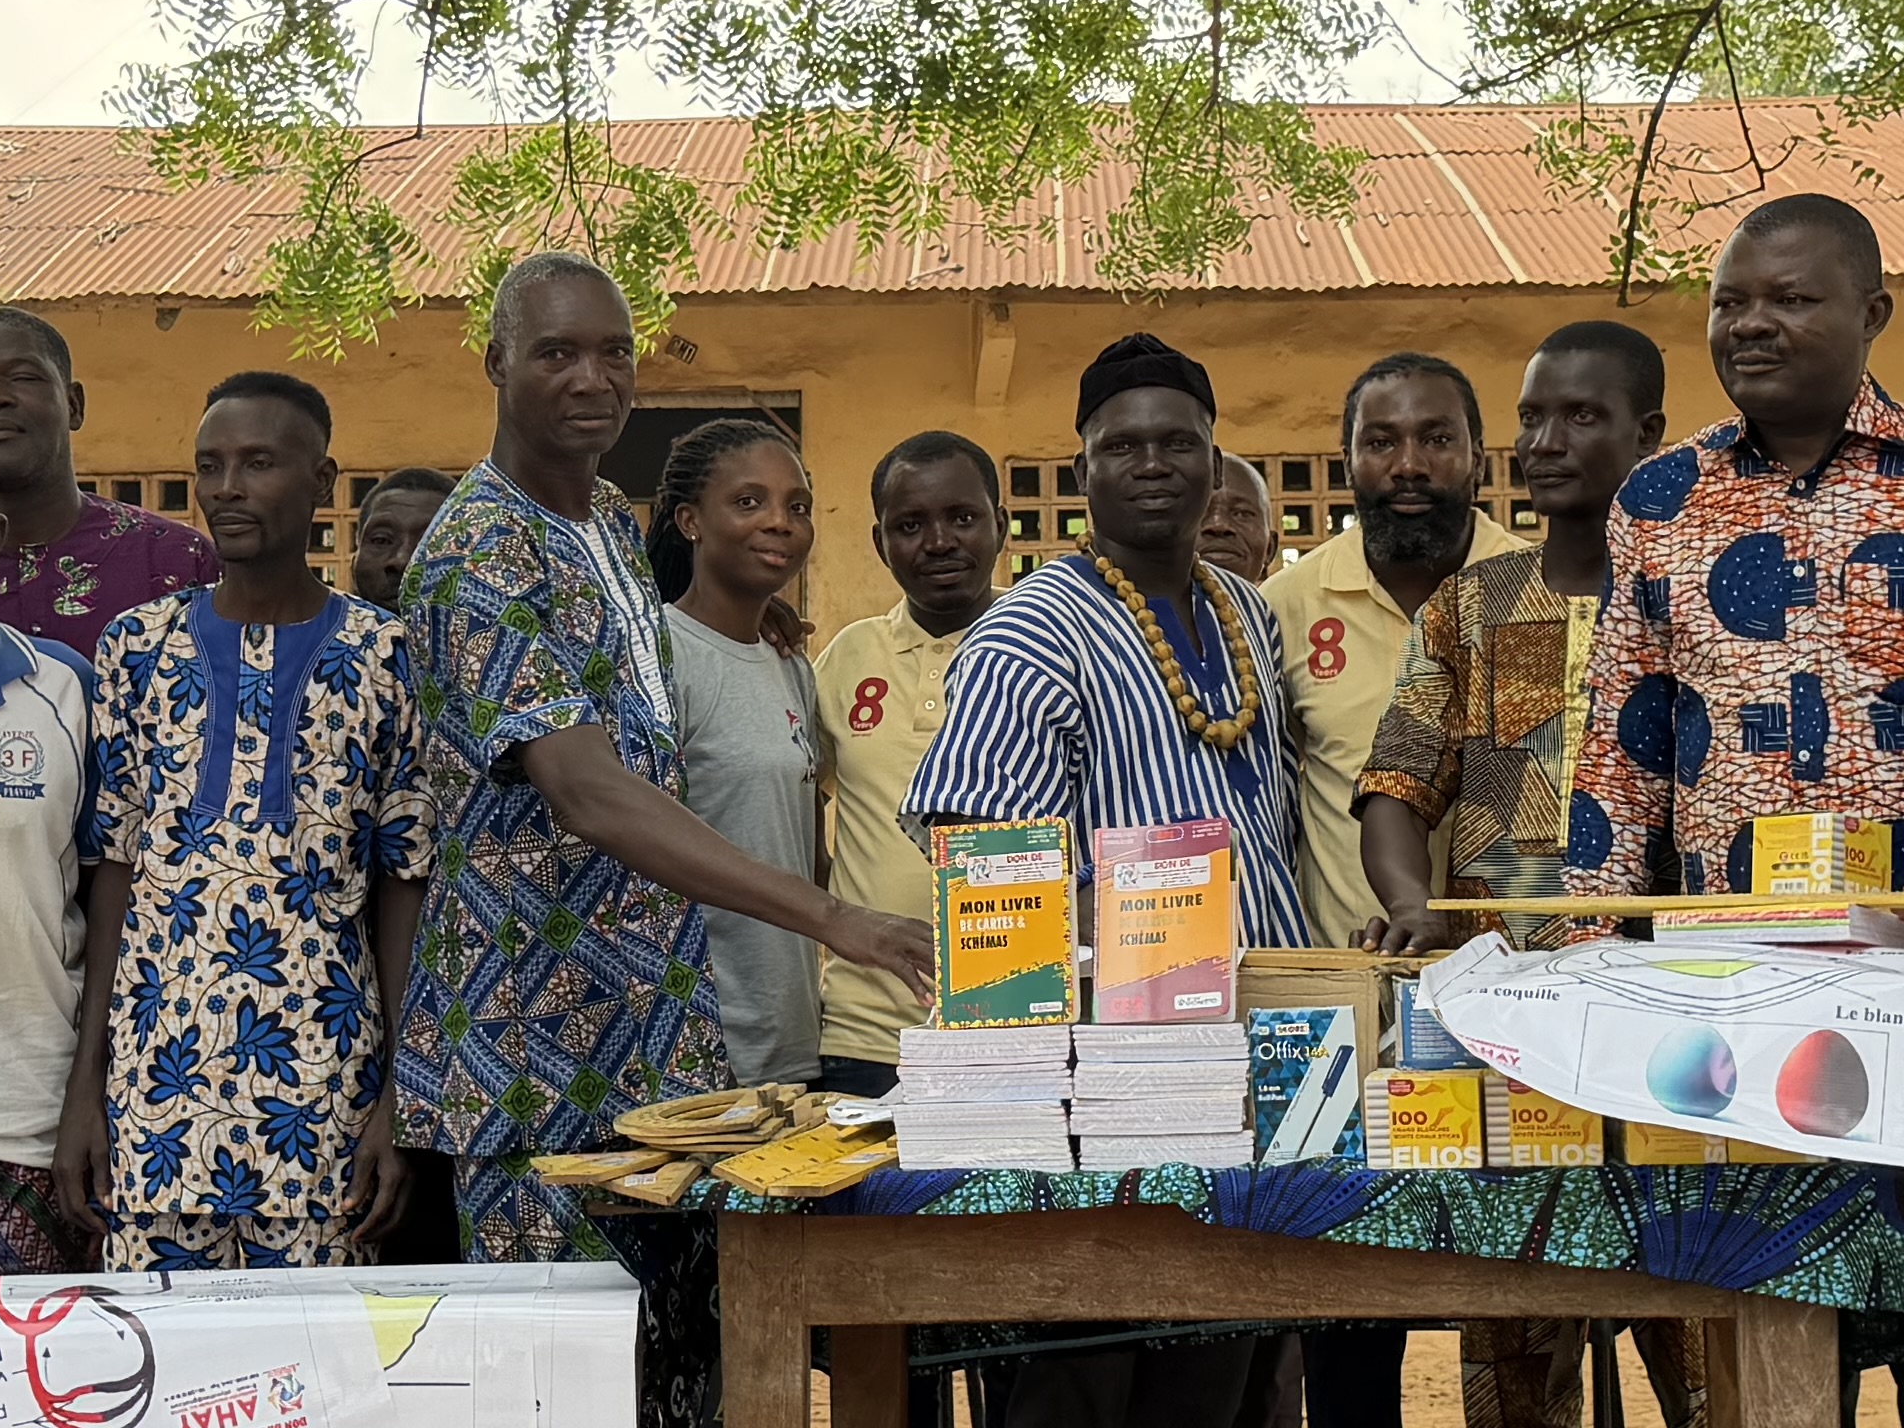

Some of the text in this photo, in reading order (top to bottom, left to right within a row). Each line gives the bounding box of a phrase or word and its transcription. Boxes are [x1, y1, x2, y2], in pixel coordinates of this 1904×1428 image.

[1307, 617, 1346, 679] 8
[848, 677, 889, 732] 8
[1, 750, 35, 768] 3 F
[960, 896, 1042, 914] MON LIVRE
[1120, 893, 1203, 912] MON LIVRE
[959, 915, 1026, 932] DE CARTES &
[961, 933, 1008, 950] SCHÉMAS
[1119, 930, 1167, 947] SCHÉMAS
[1494, 987, 1560, 1001] coquille
[1836, 1005, 1858, 1020] Le
[1258, 1040, 1304, 1061] Offix
[1392, 1111, 1427, 1125] 100
[1512, 1109, 1548, 1123] 100
[1393, 1146, 1482, 1168] ELIOS
[1512, 1144, 1603, 1166] ELIOS
[284, 1417, 308, 1428] DON
